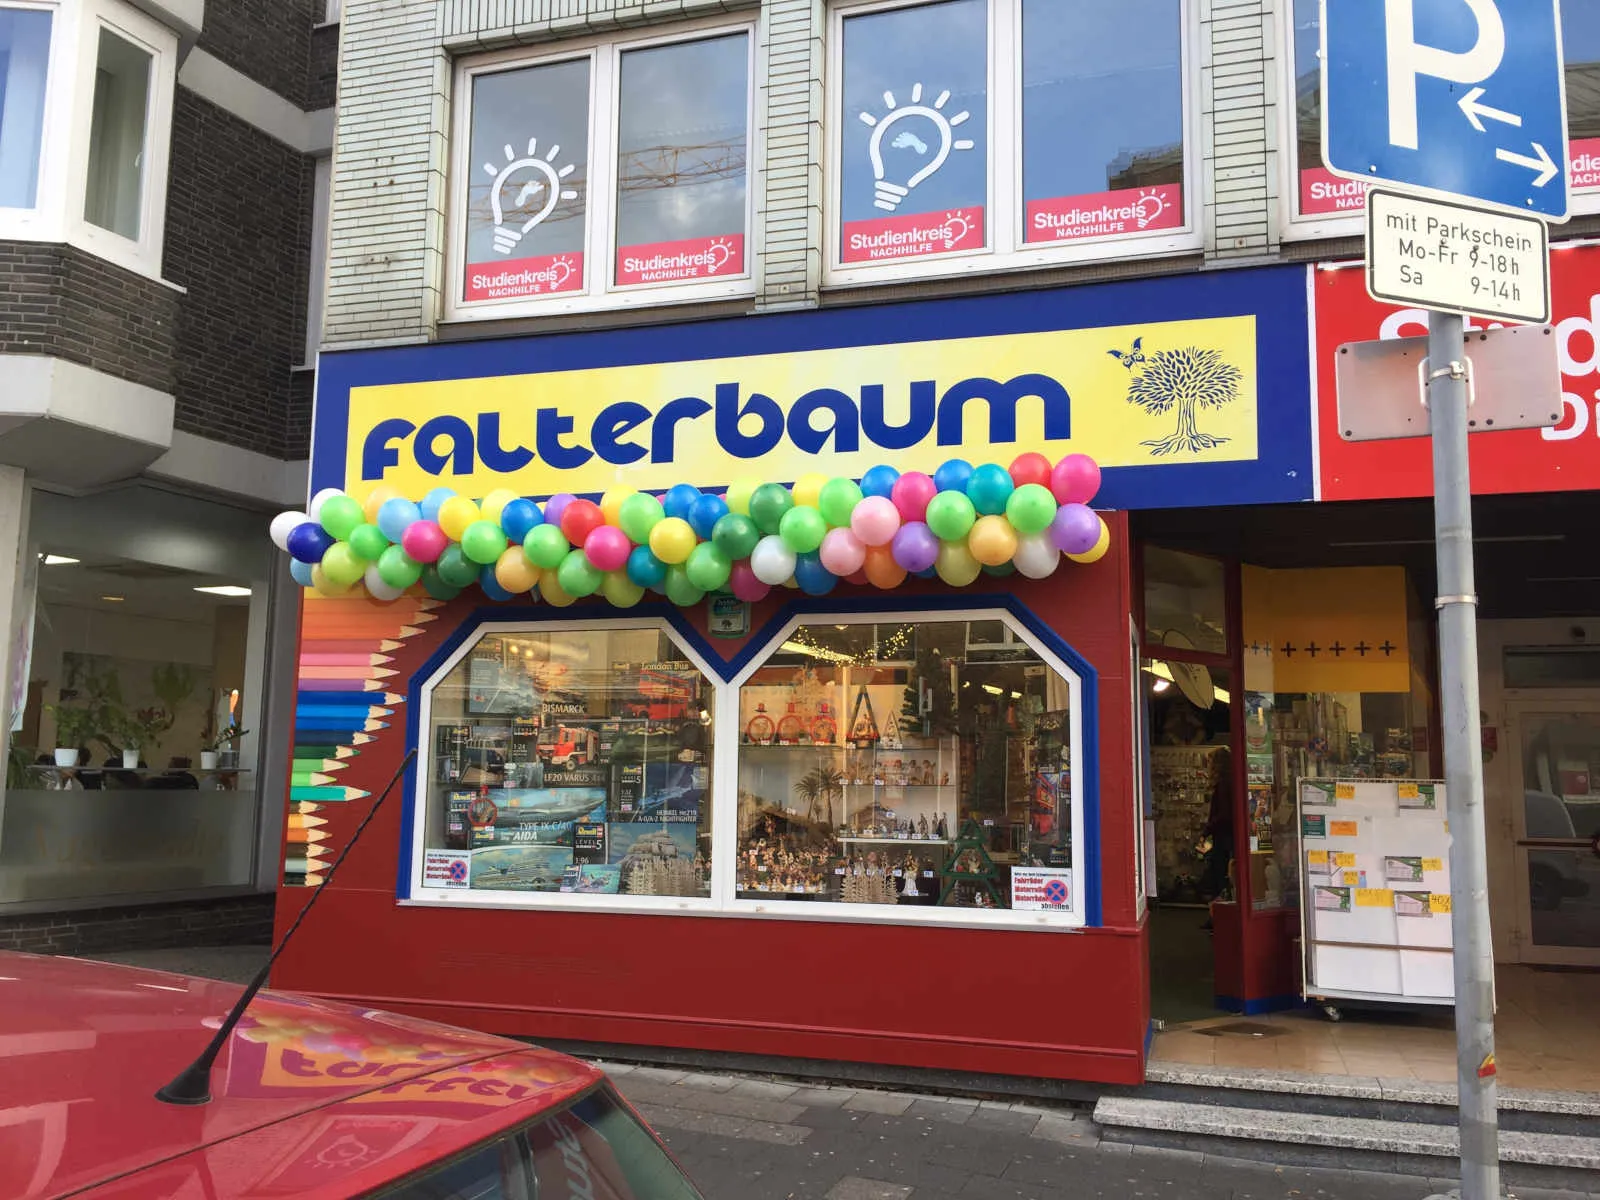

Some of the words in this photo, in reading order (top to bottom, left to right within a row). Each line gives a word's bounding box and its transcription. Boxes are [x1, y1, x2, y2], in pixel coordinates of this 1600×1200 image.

[1034, 204, 1146, 229] Studienkreis
[850, 226, 953, 250] Studienkreis
[1056, 222, 1125, 237] NACHHILFE
[1387, 213, 1417, 232] mit
[1427, 216, 1532, 252] Parkschein
[870, 242, 933, 257] NACHHILFE
[1399, 238, 1459, 264] Mo-Fr
[624, 251, 716, 273] Studienkreis
[472, 269, 558, 289] Studienkreis
[641, 267, 698, 281] NACHHILFE
[1400, 264, 1423, 285] Sa
[488, 283, 541, 297] NACHHILFE
[542, 703, 585, 714] BISMARCK
[512, 831, 538, 841] AIDA
